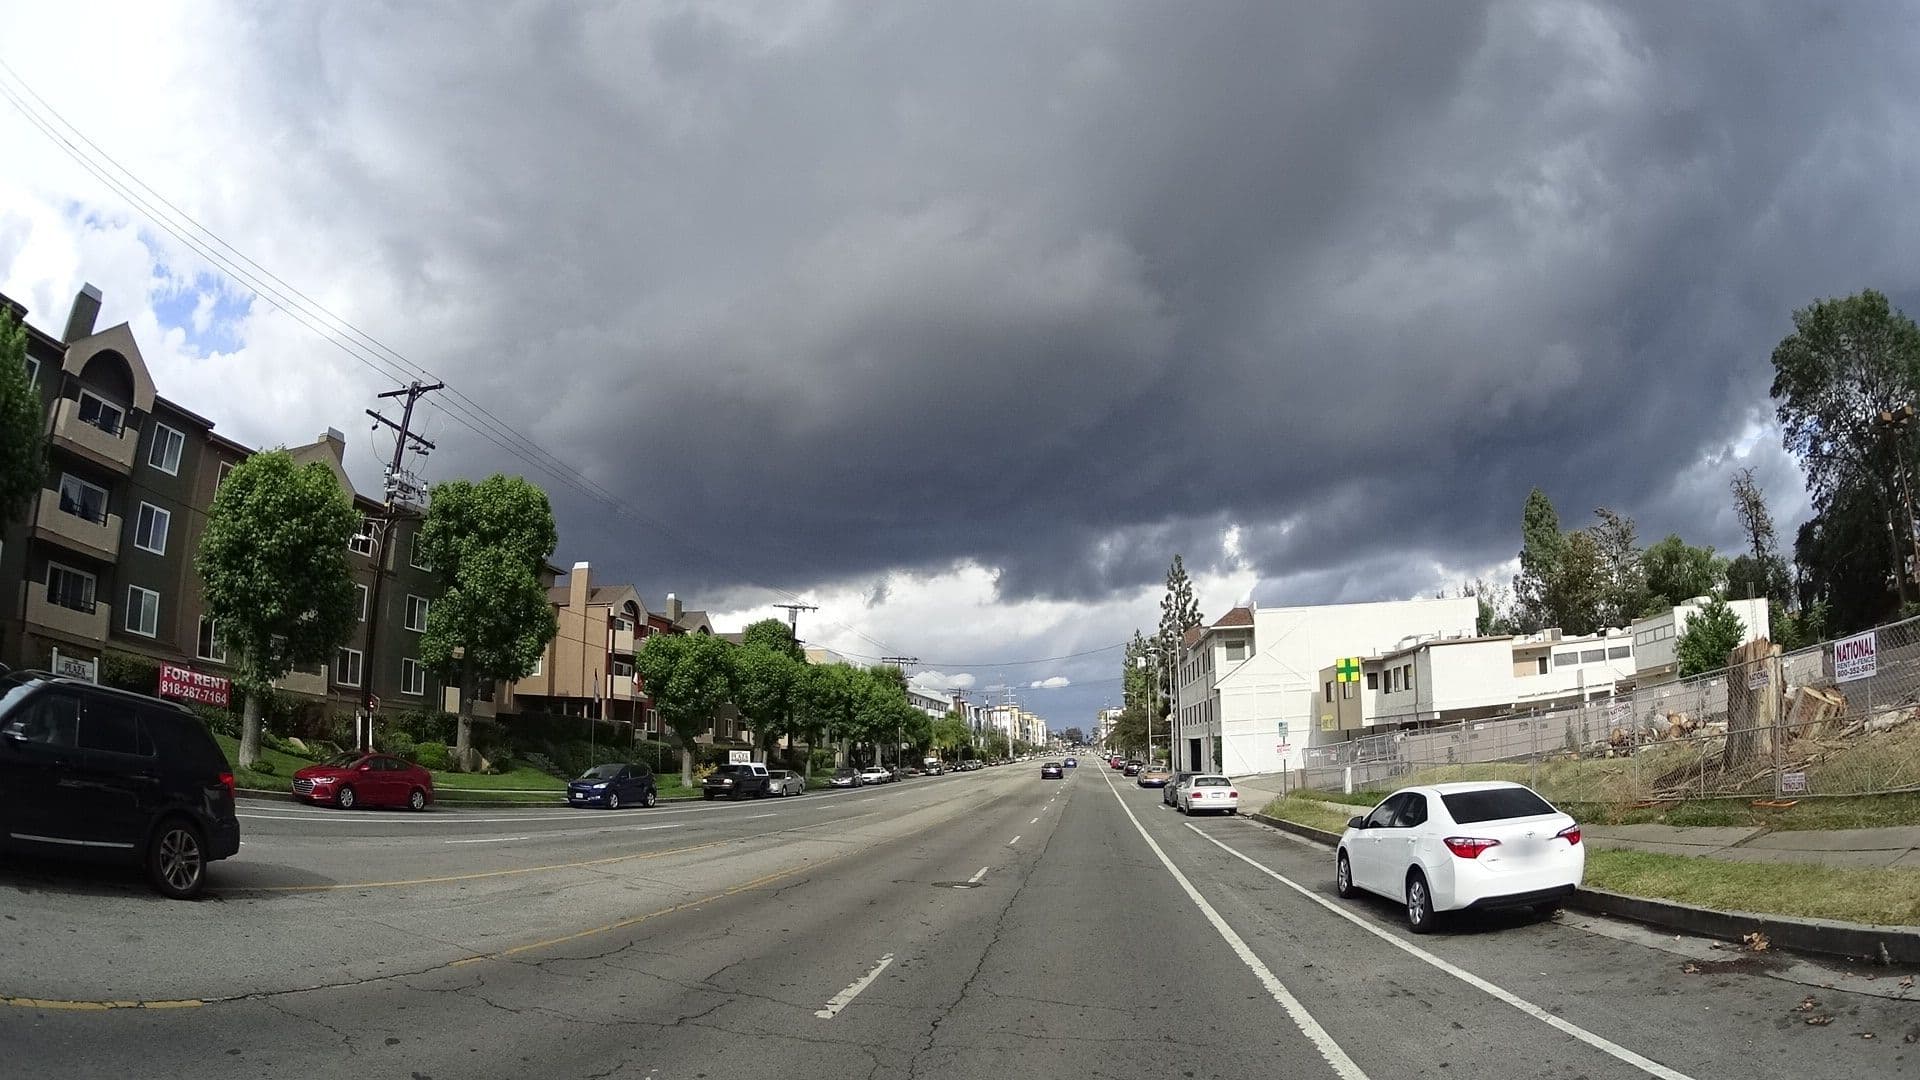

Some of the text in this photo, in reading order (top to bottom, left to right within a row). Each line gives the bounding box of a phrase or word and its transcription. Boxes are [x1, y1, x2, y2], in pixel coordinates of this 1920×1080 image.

[1836, 637, 1874, 662] NATIONAL
[64, 662, 87, 677] PLAZA
[1836, 656, 1874, 669] RENT-A-FENCE
[164, 666, 229, 691] FOR RENT
[162, 680, 227, 704] 818-287-7164
